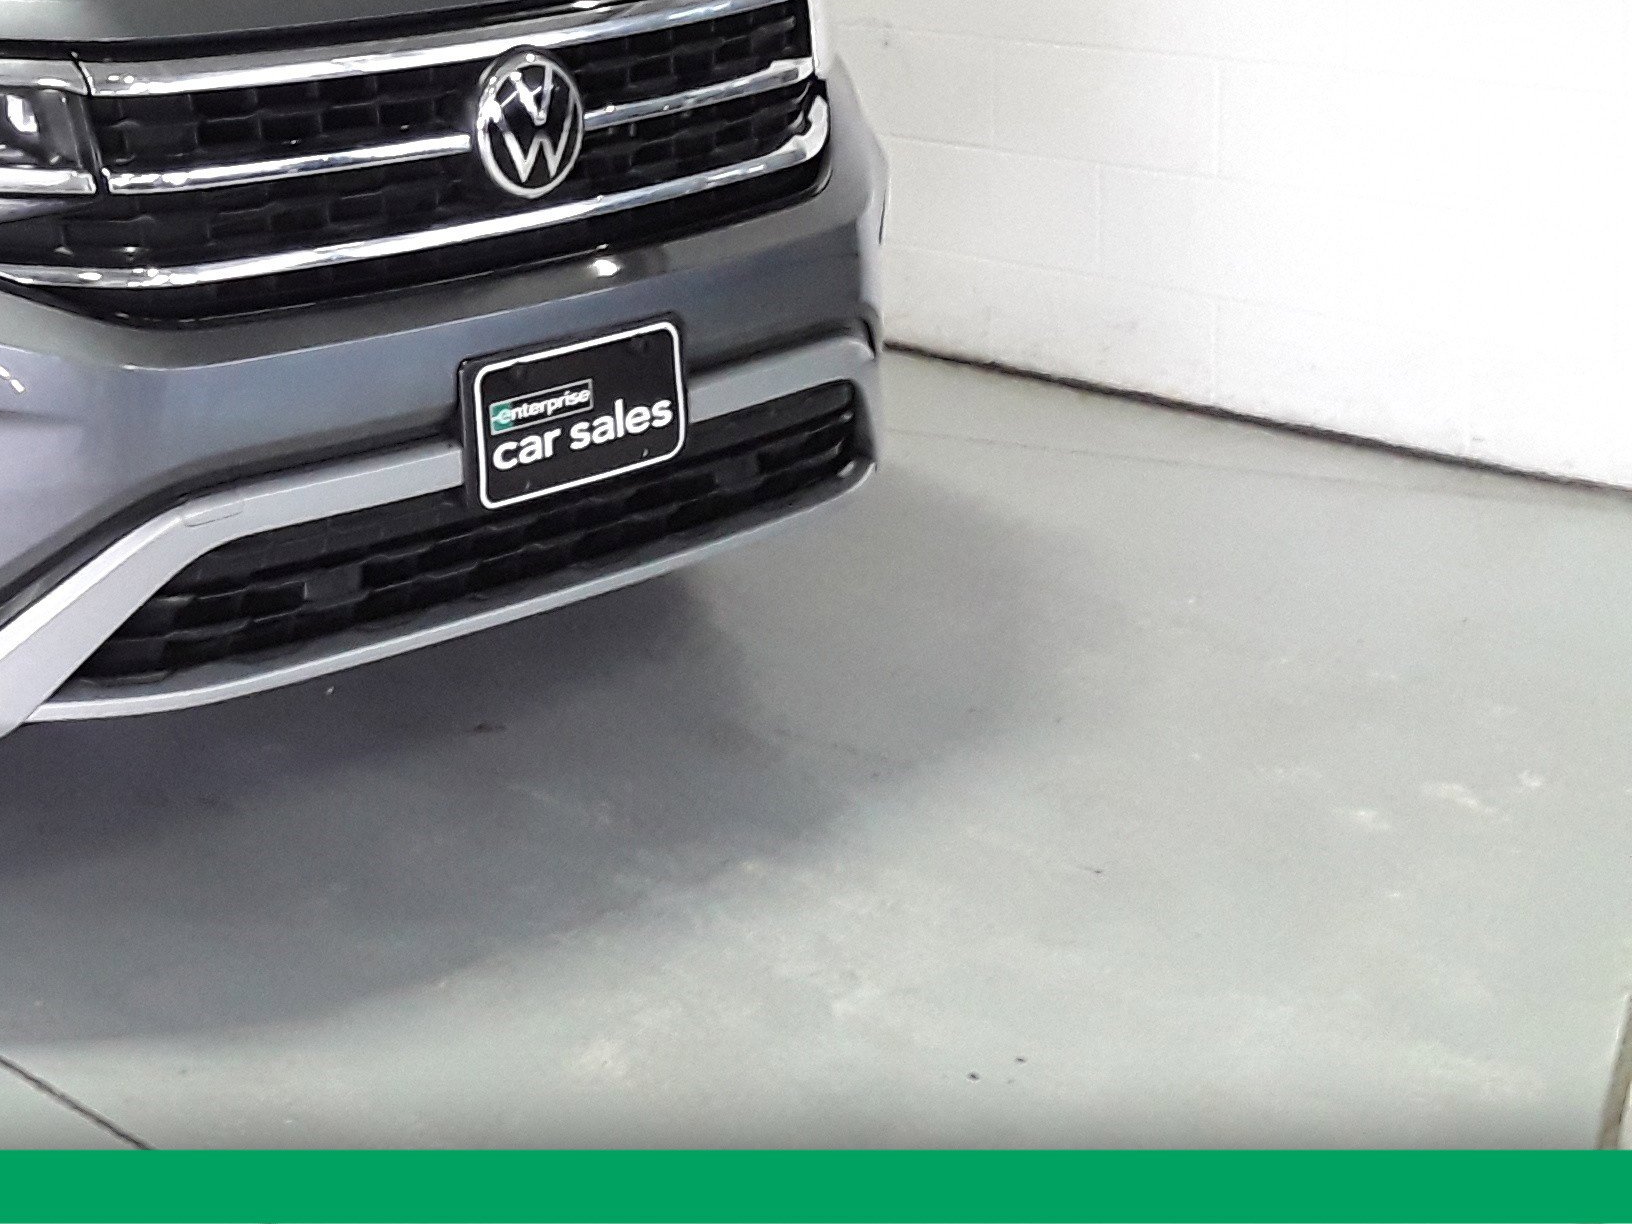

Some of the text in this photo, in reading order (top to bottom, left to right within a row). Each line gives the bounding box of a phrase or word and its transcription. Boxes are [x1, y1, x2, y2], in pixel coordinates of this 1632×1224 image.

[492, 389, 591, 425] enterprise
[492, 398, 674, 471] car sales
